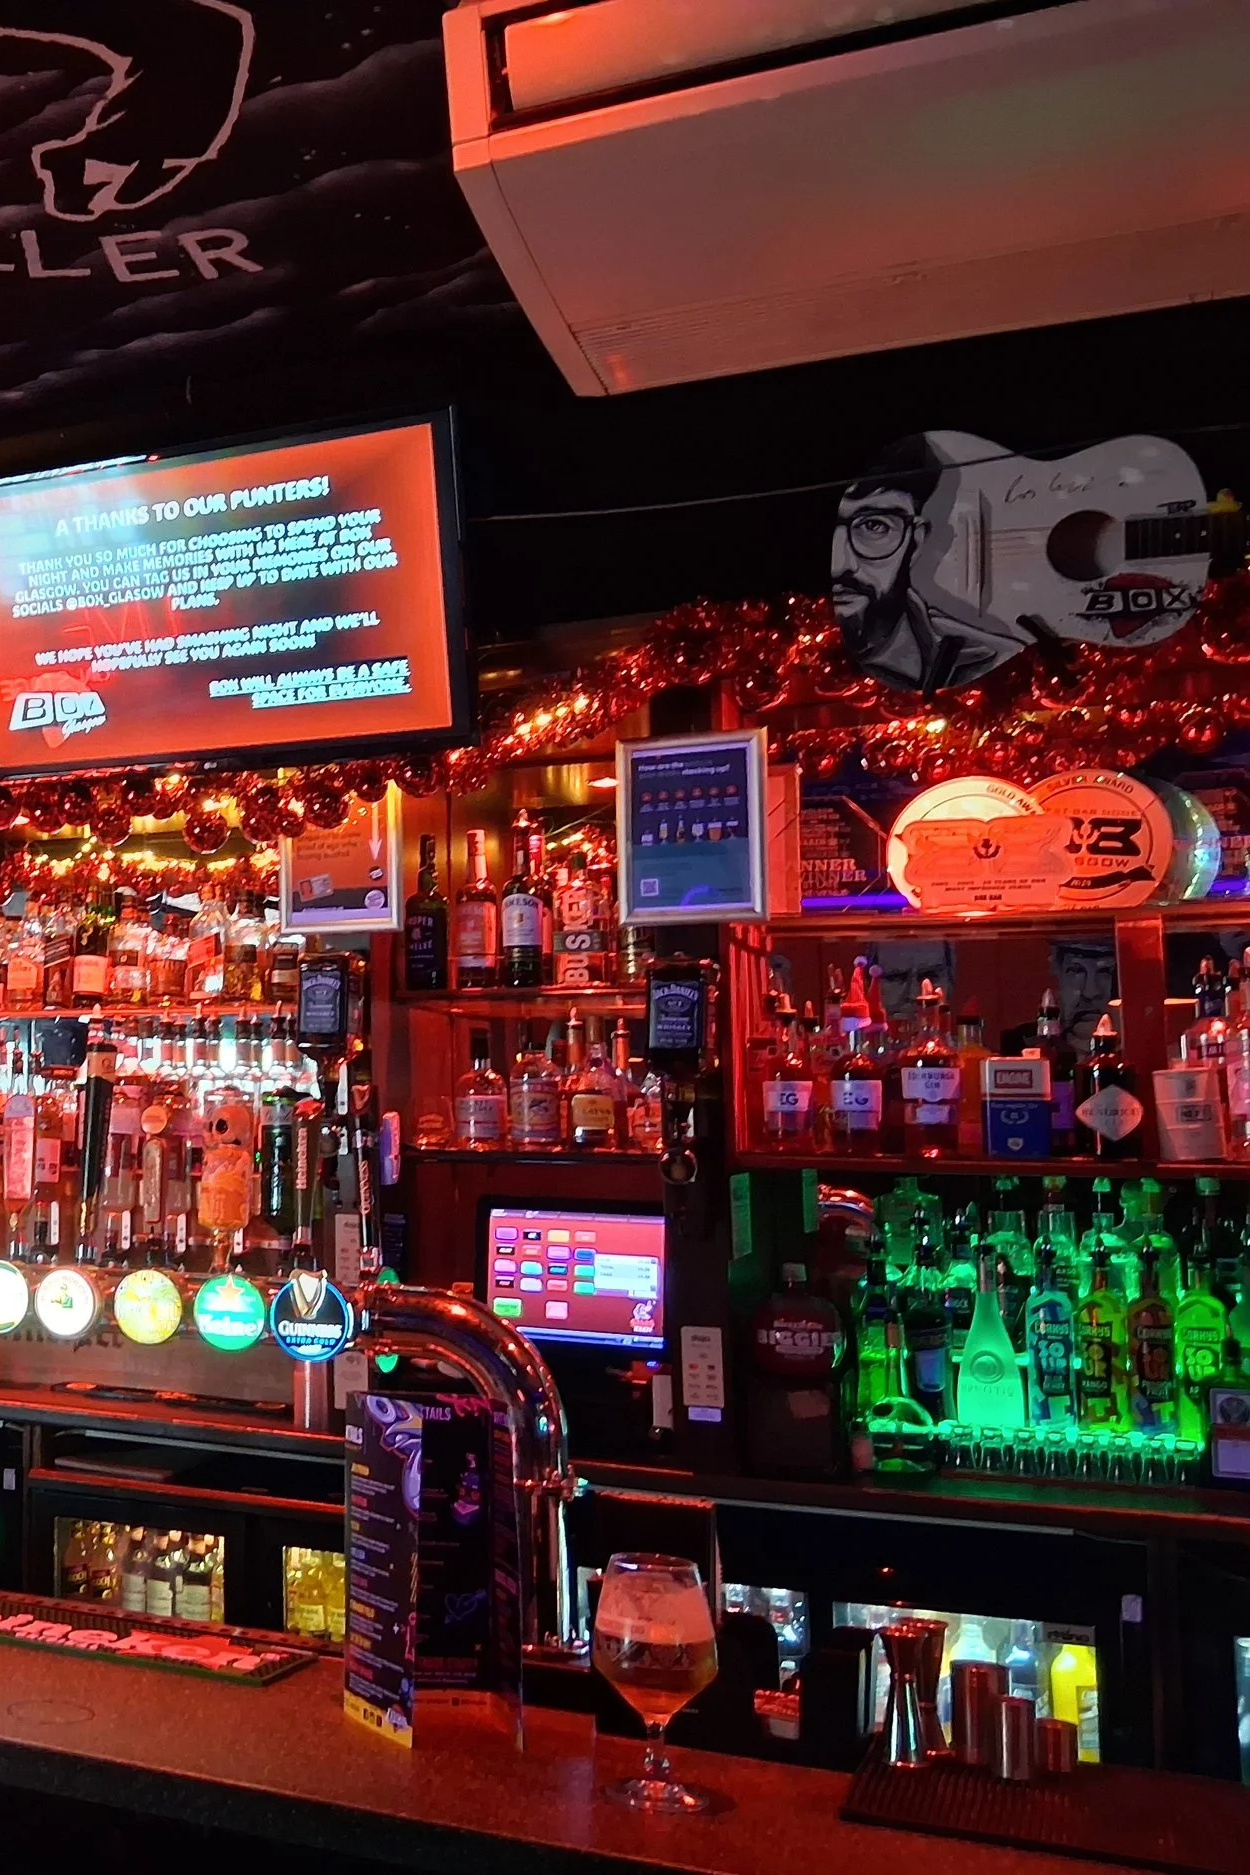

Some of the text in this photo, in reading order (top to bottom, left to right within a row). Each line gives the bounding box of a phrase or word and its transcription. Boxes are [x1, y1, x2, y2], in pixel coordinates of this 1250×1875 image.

[55, 475, 331, 537] A THANKS TO OUR PUNTERS!
[14, 537, 393, 604] GLASGOW. YOU CAN TAG US IN YOUR MEMORIES ON OUR
[19, 508, 381, 575] THANK YOU SO MUCH FOR CHOOSING TO SPEND YOUR
[28, 525, 372, 587] NIGHT AND MAKE MEMORIES WITH US HERE AT BOX
[12, 600, 64, 619] SOCIALS
[167, 580, 198, 598] AND
[200, 575, 235, 594] KEEP
[235, 571, 257, 589] UP
[258, 568, 280, 586] TO
[281, 563, 320, 583] DATE
[320, 557, 362, 578] WITH
[363, 551, 398, 570] OUR
[1085, 585, 1197, 614] BOX
[986, 784, 1016, 800] GOLD
[563, 889, 592, 983] BUSKER
[278, 1320, 343, 1339] GUINNESS
[286, 1336, 337, 1346] EXTRA COLD
